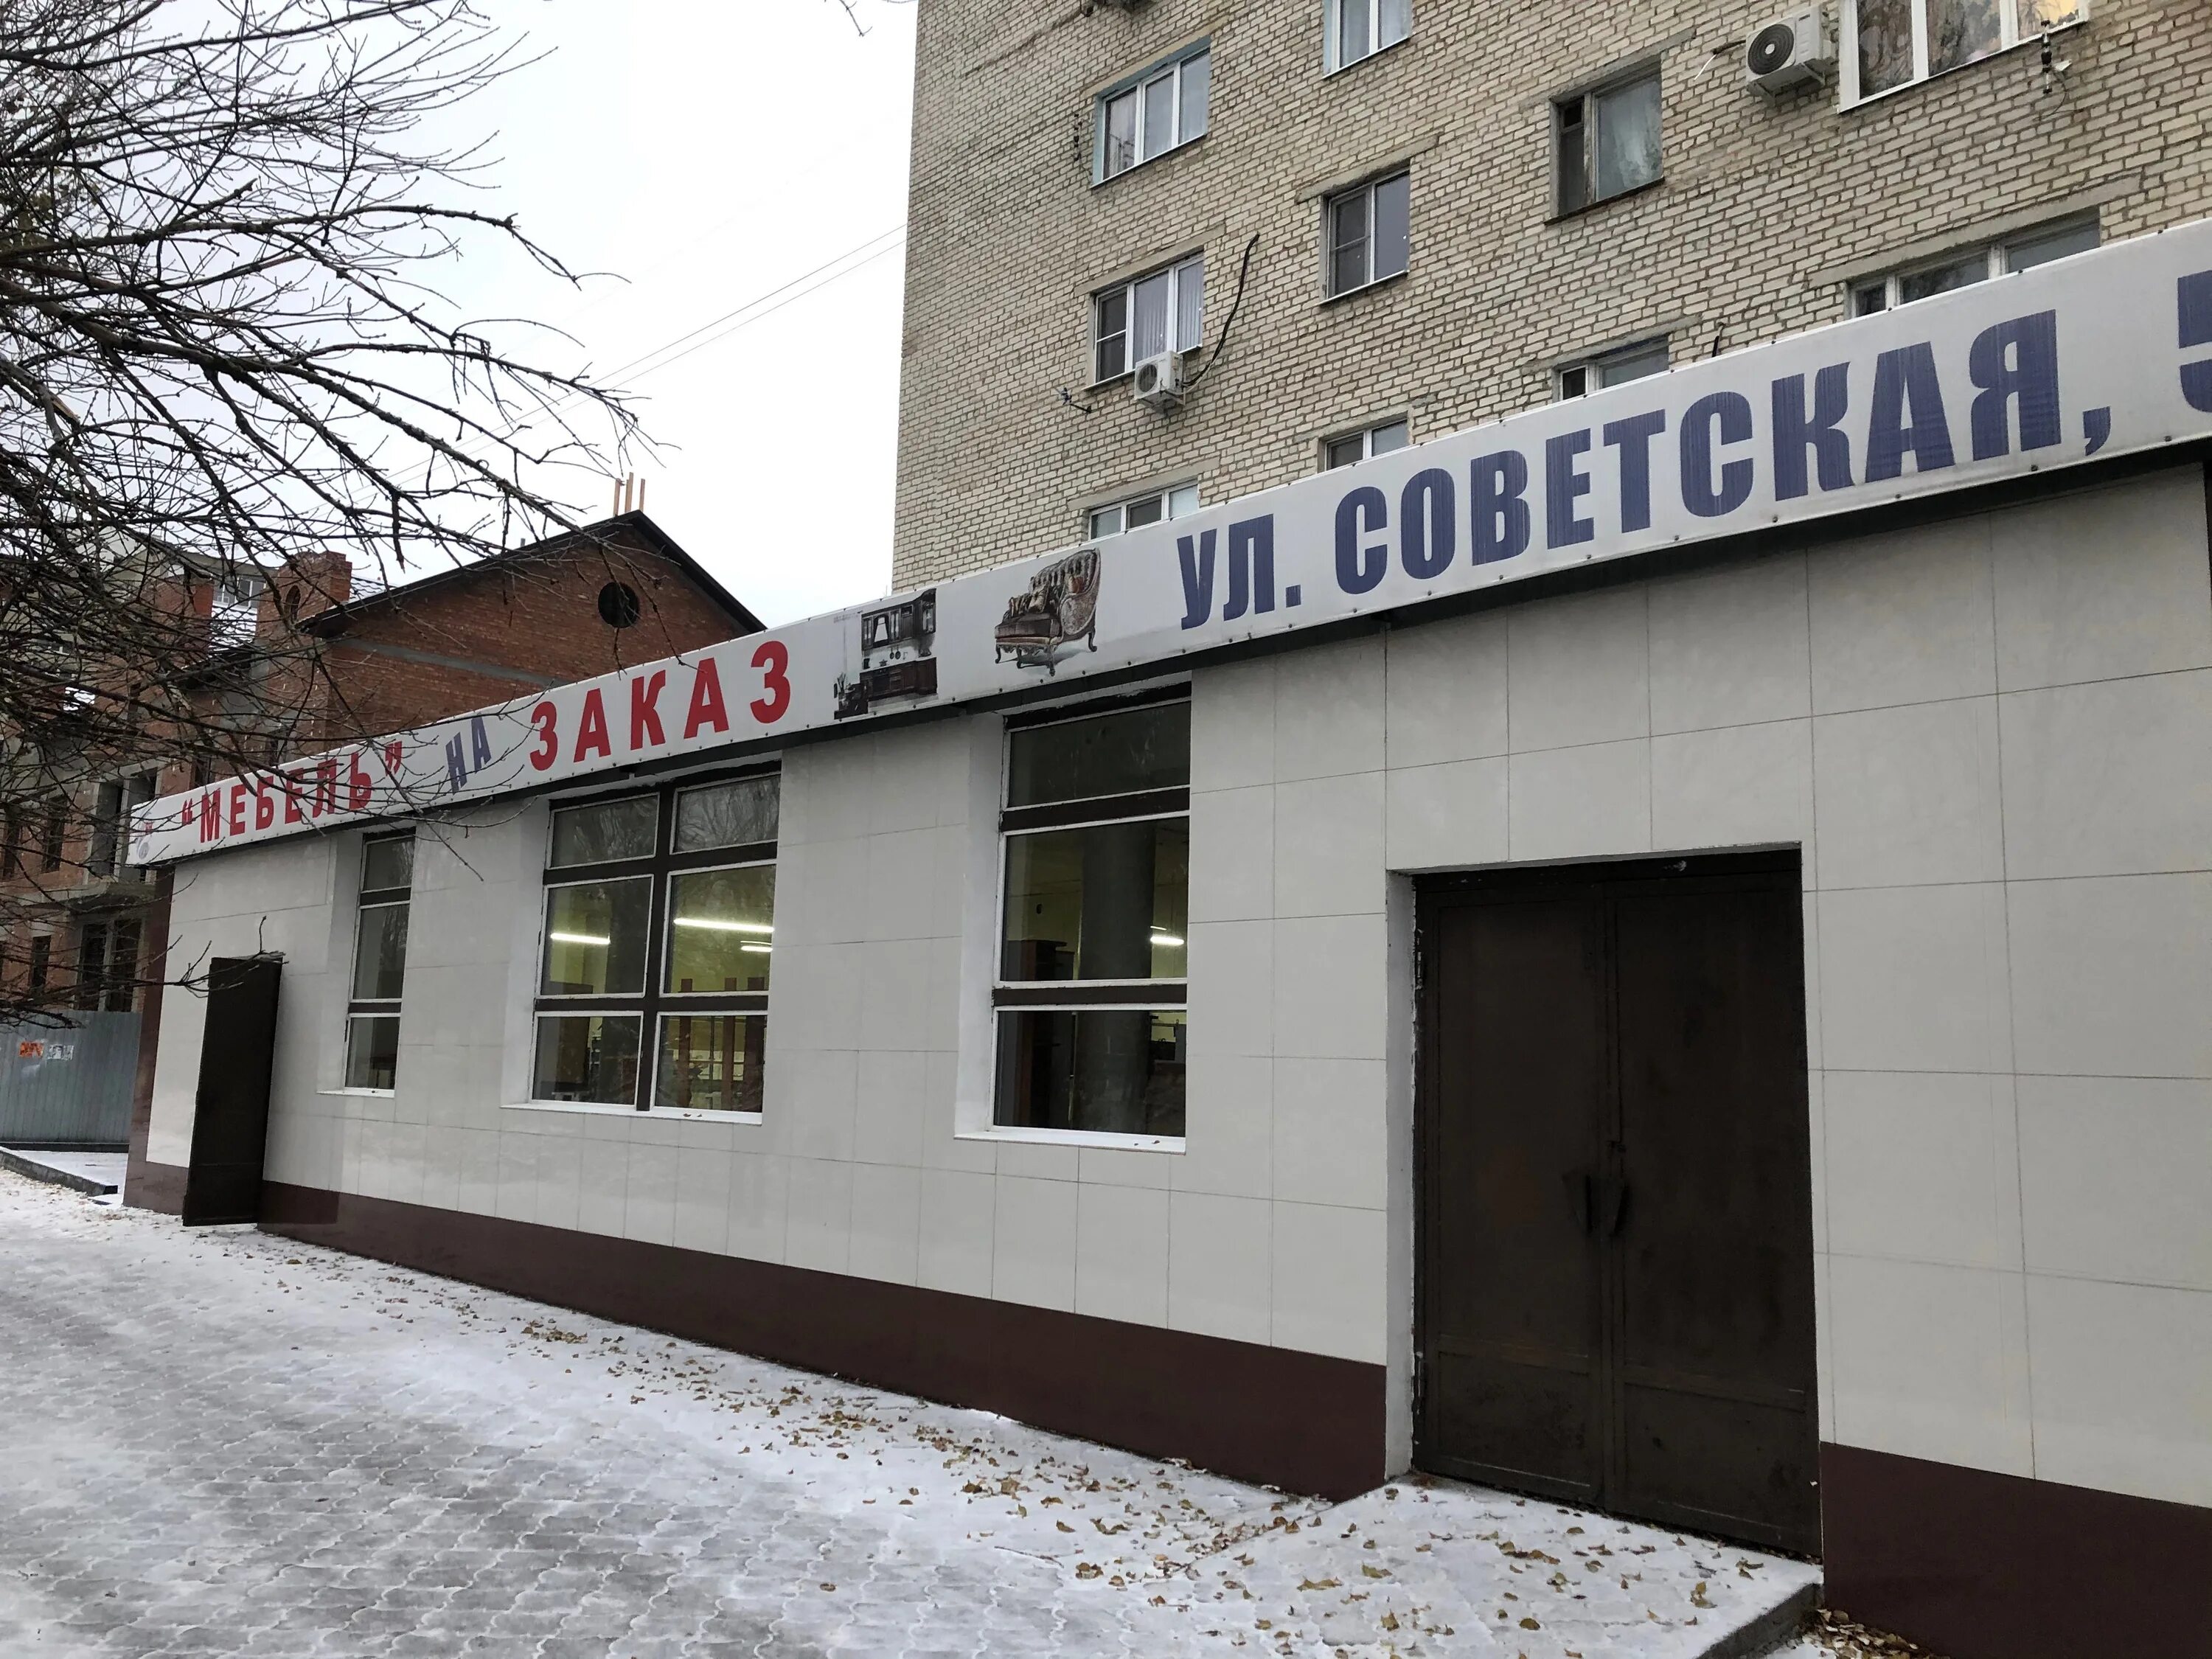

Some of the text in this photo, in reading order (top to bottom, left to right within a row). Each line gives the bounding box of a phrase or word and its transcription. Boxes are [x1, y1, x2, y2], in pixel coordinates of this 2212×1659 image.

[1177, 513, 1301, 630] УЛ.
[1335, 308, 2112, 595] СОВЕТСКАЯ,
[446, 716, 492, 795] НА
[529, 641, 791, 771] ЗАКАЗ
